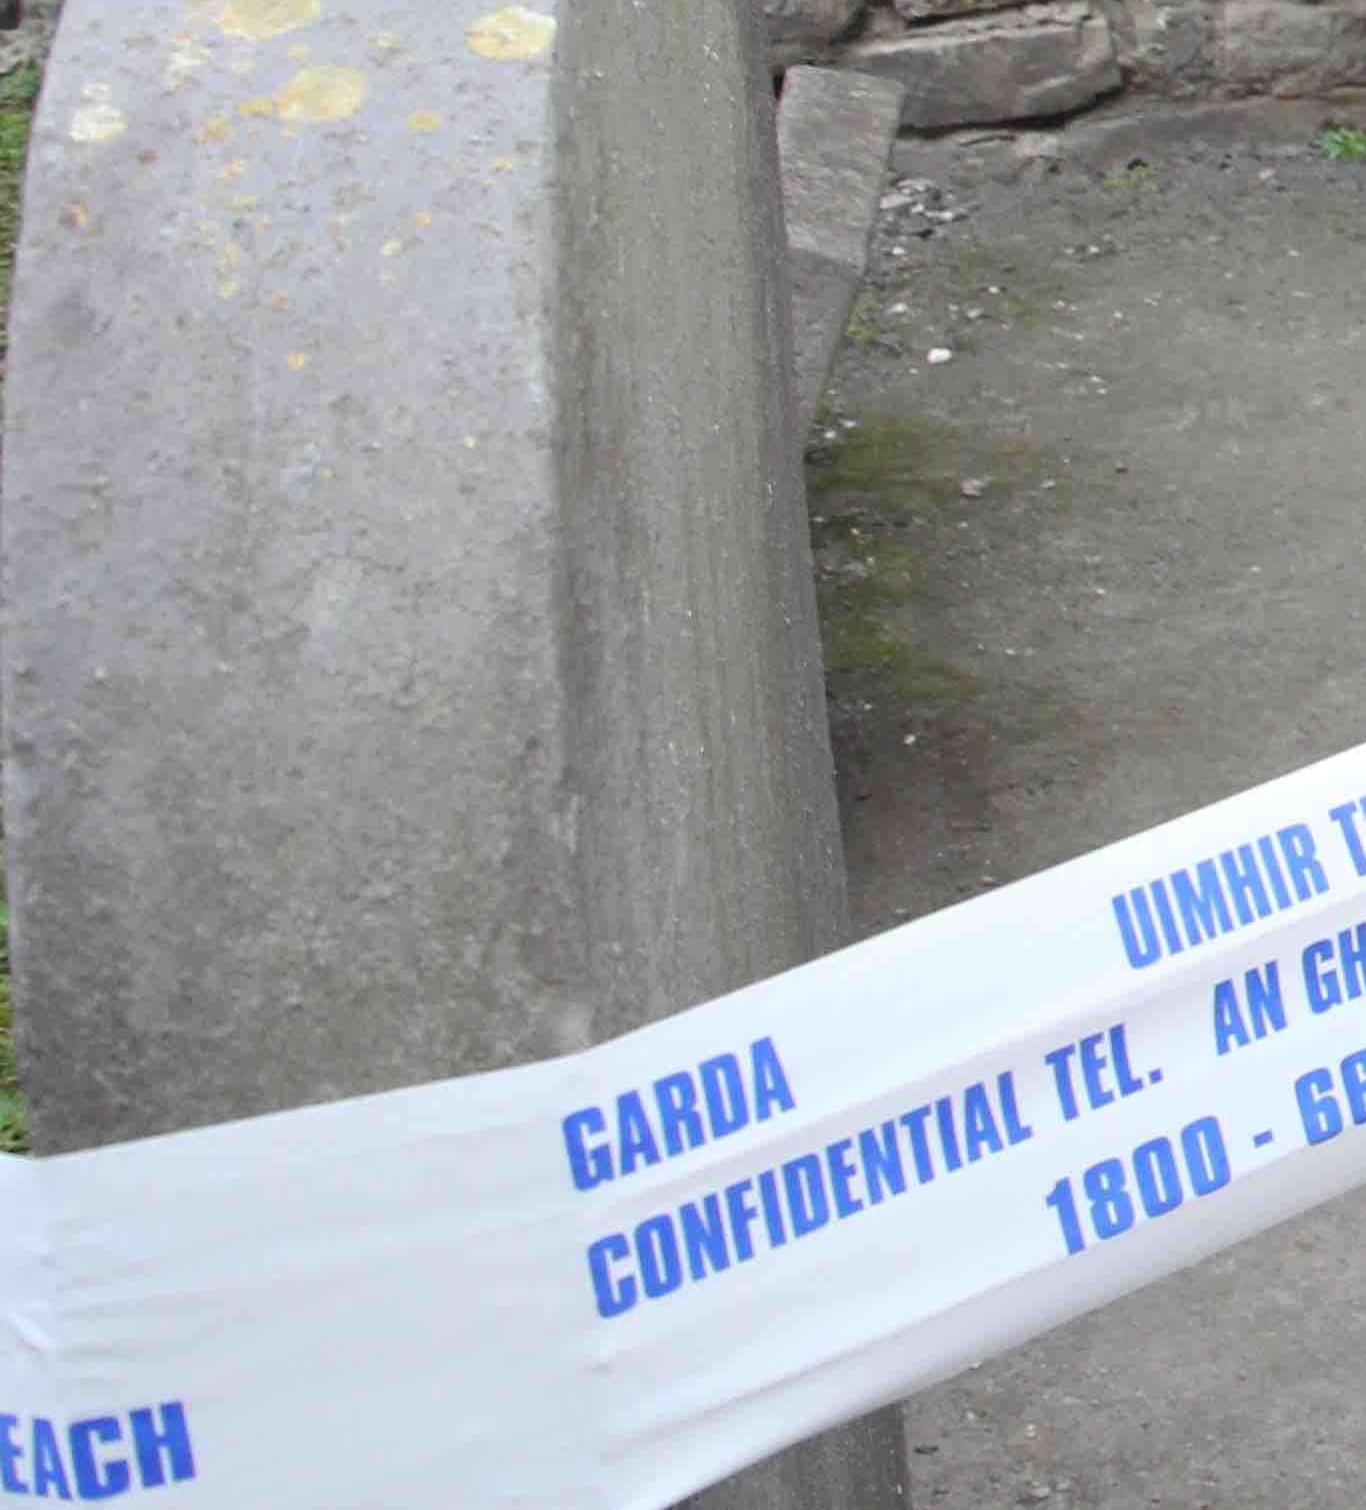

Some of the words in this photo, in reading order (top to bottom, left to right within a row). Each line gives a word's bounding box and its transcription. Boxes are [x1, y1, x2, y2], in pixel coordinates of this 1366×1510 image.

[1111, 822, 1330, 970] UIMHIR
[1211, 959, 1288, 1056] AN
[561, 1036, 796, 1192] GARDA
[586, 1070, 1033, 1320] CONFIDENTIAL
[1043, 1022, 1163, 1122] TEL.
[1045, 1114, 1232, 1257] 1800
[1253, 1128, 1274, 1148] -
